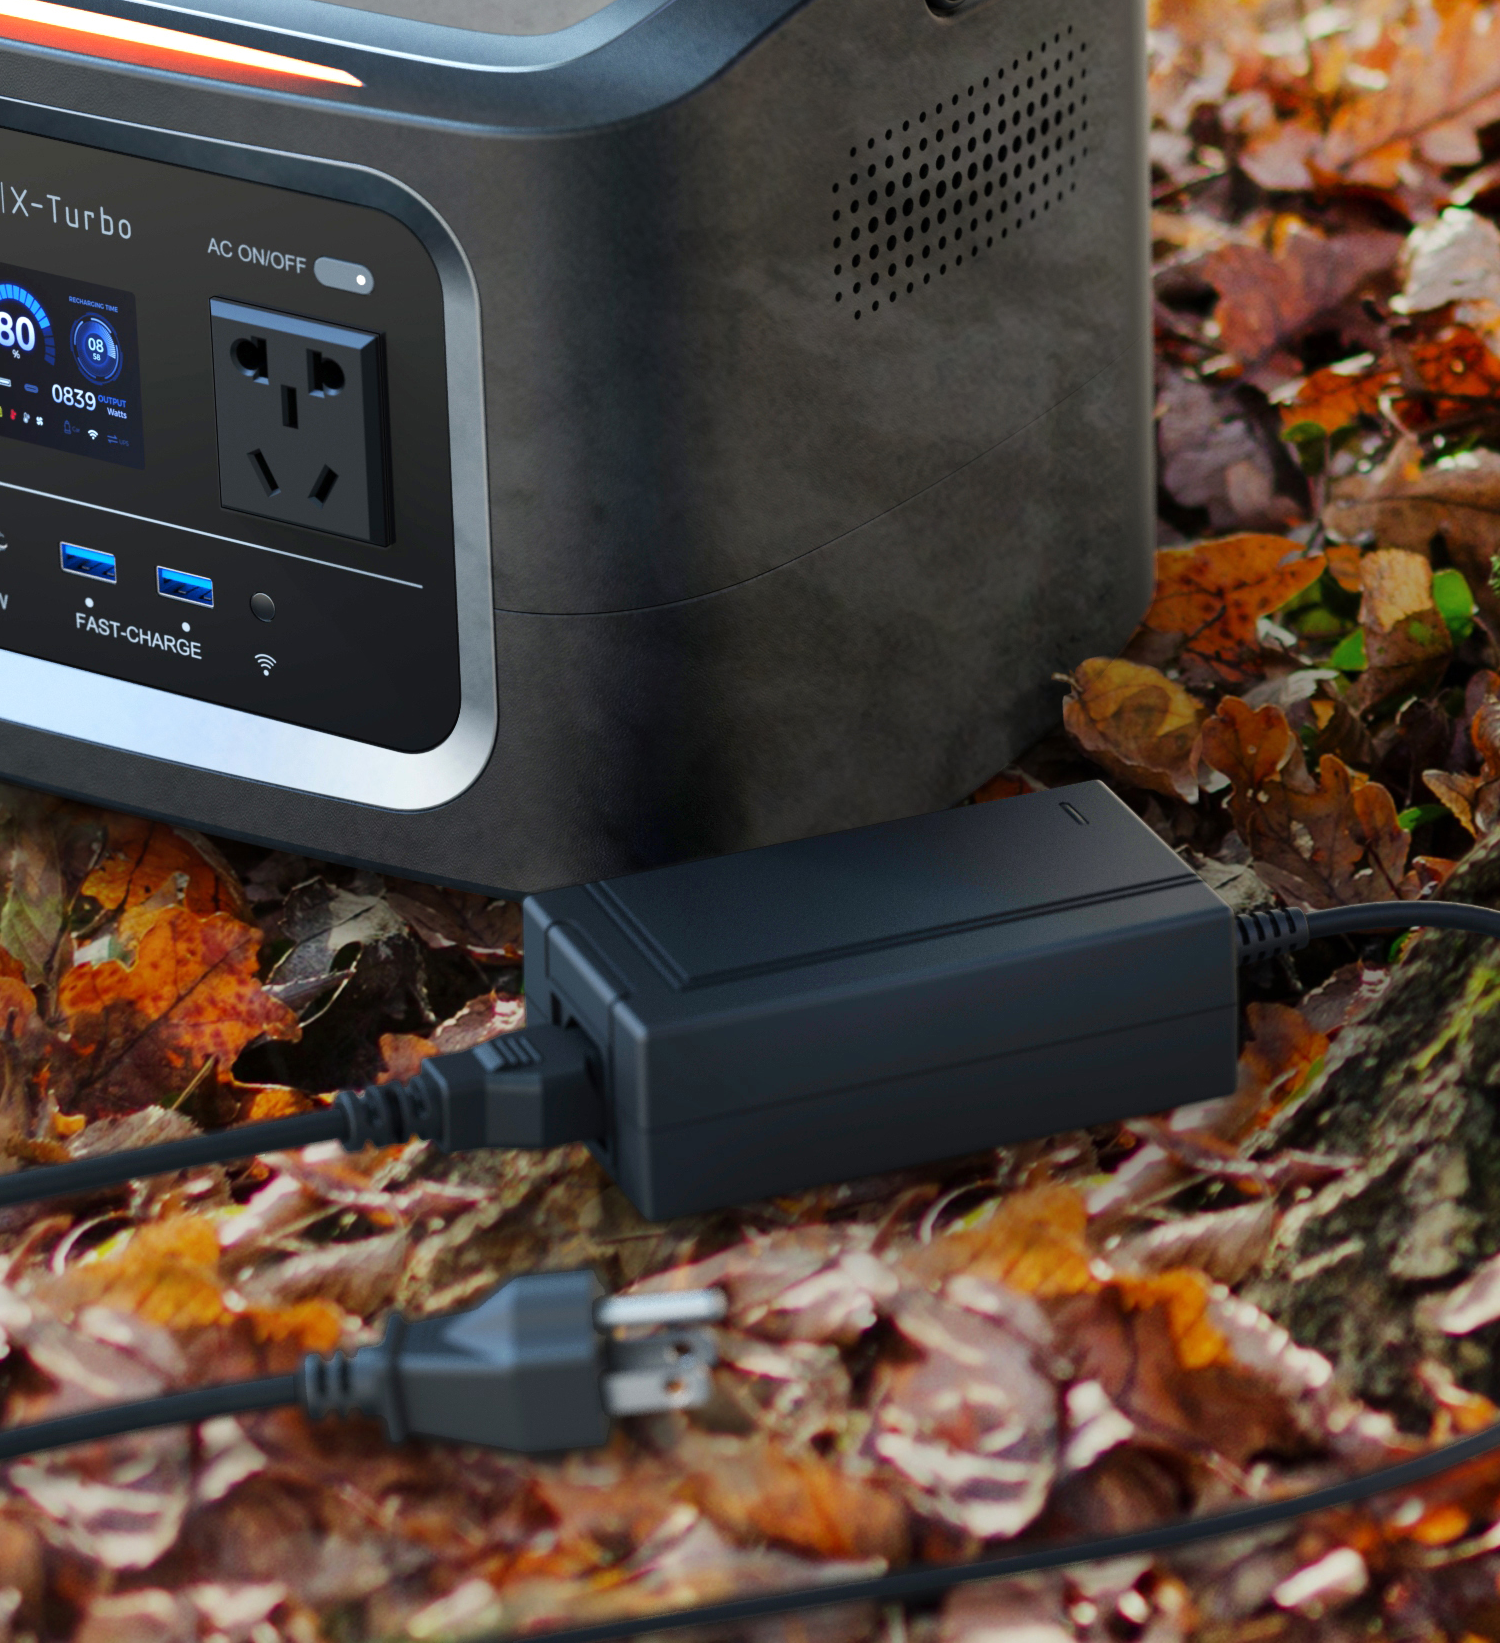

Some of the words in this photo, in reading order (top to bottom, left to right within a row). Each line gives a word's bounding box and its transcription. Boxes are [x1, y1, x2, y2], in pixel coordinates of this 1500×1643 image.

[10, 186, 132, 240] X-Turbo
[207, 238, 233, 258] AC
[238, 244, 307, 274] ON/OFF
[68, 296, 105, 310] RECHARGING
[105, 304, 119, 313] TIME
[12, 349, 21, 360] %
[87, 337, 105, 353] 08
[51, 383, 97, 411] 0839
[97, 394, 127, 408] OUTPUT
[107, 407, 128, 420] Watts
[75, 612, 203, 660] FAST-CHARGE
